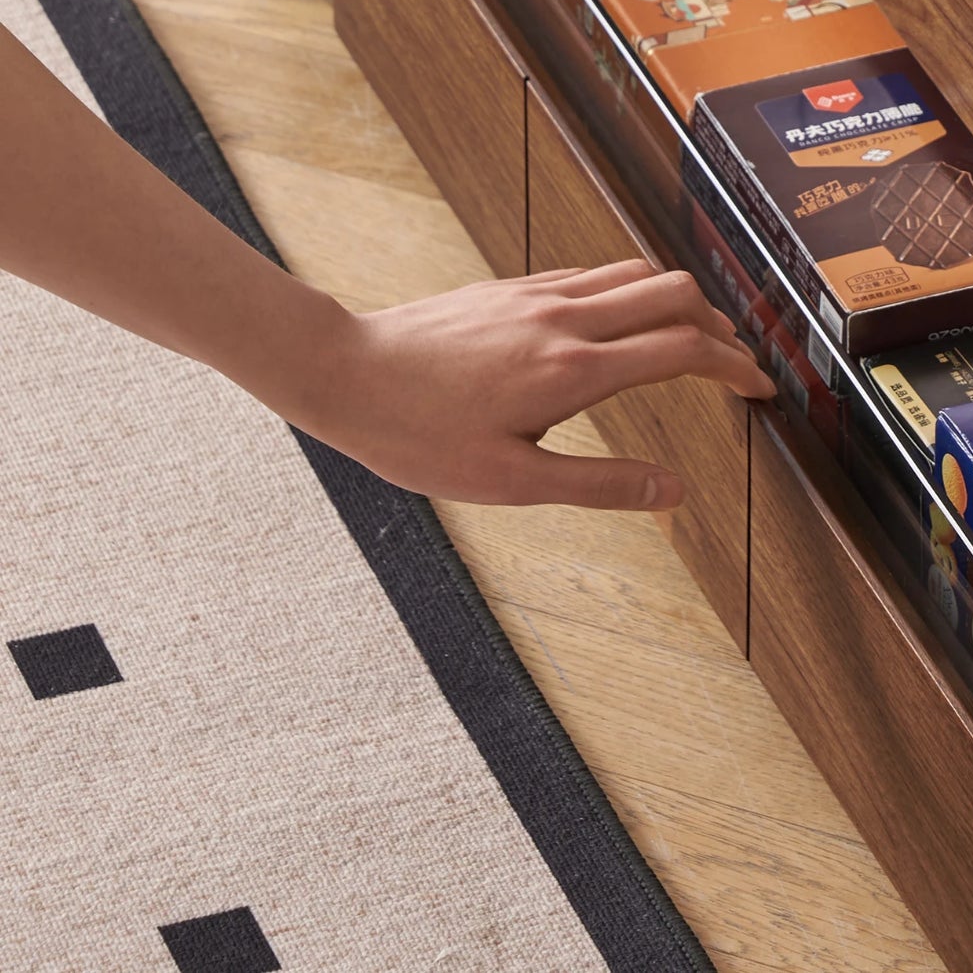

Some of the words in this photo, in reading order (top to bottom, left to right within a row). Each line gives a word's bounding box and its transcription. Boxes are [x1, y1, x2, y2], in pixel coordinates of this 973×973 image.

[785, 102, 924, 143] 丹夫巧克力薄脆
